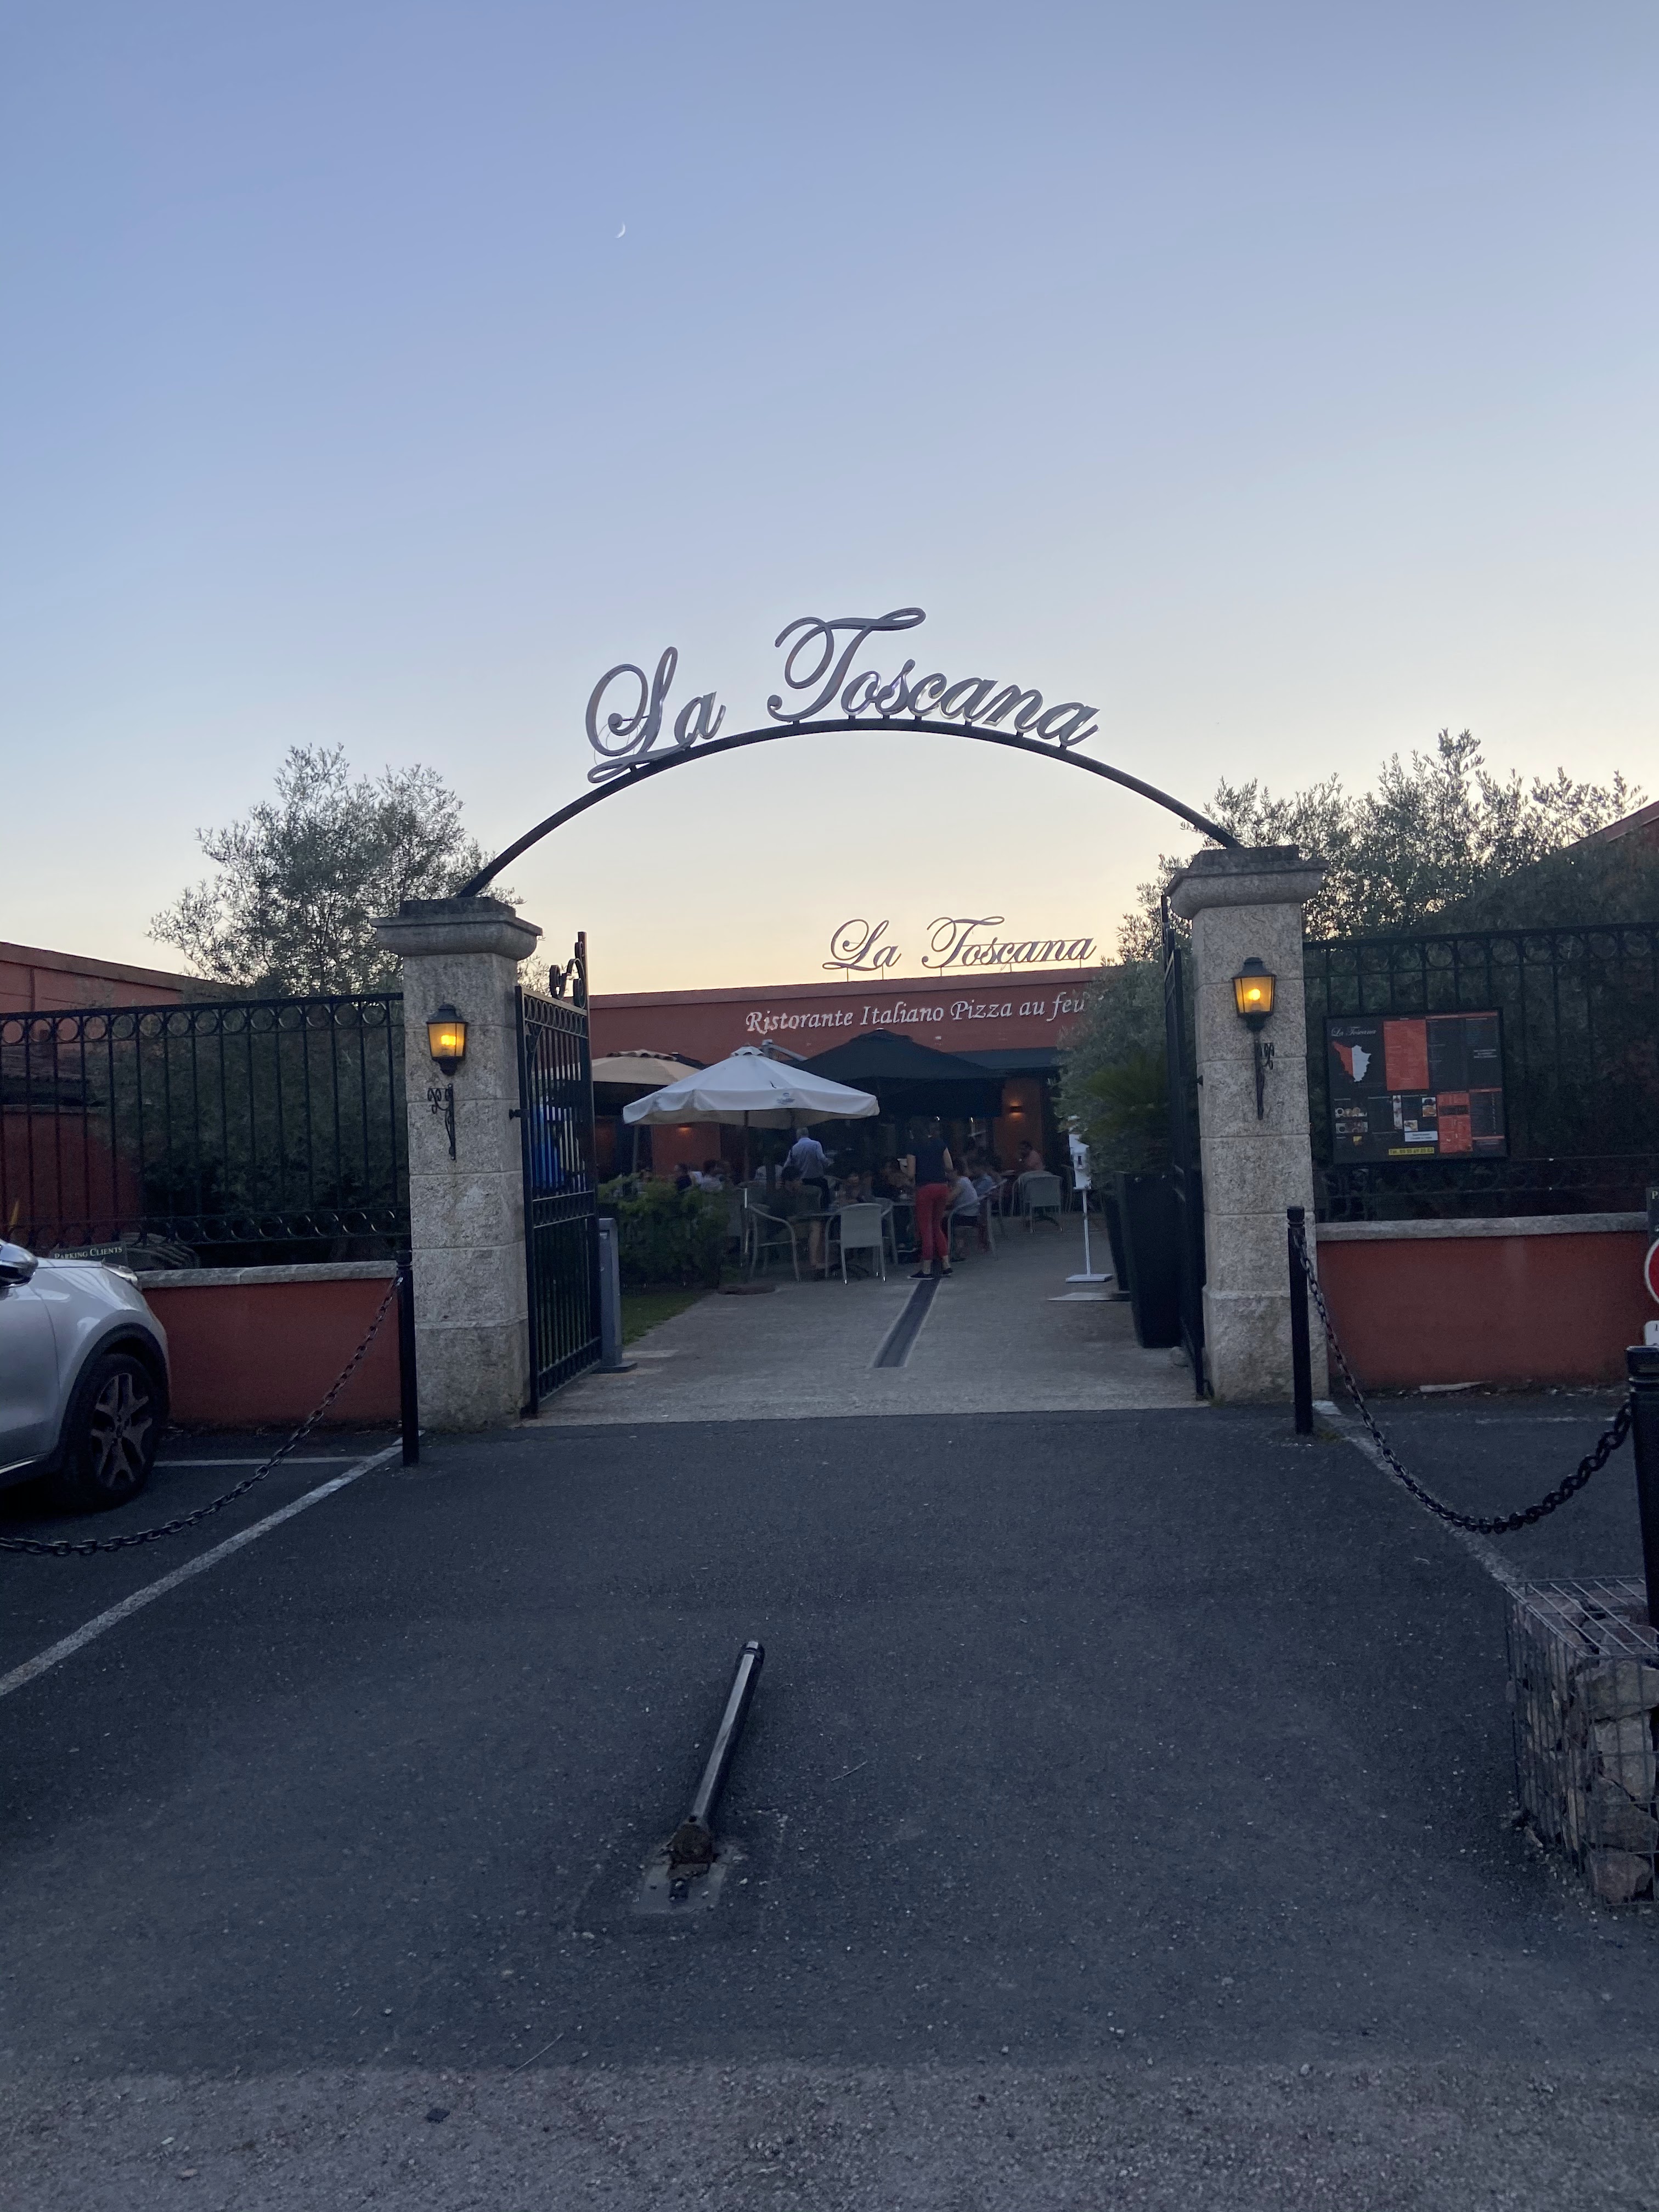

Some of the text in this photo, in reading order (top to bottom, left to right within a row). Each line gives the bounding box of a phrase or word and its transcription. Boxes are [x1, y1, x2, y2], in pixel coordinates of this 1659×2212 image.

[585, 607, 1099, 783] La Toscana
[822, 916, 1097, 970] La Toscana
[746, 991, 1086, 1035] Ristorante Italiano Pizza au feu
[1331, 1027, 1344, 1036] La
[54, 1246, 122, 1260] PARKING CLIENTS
